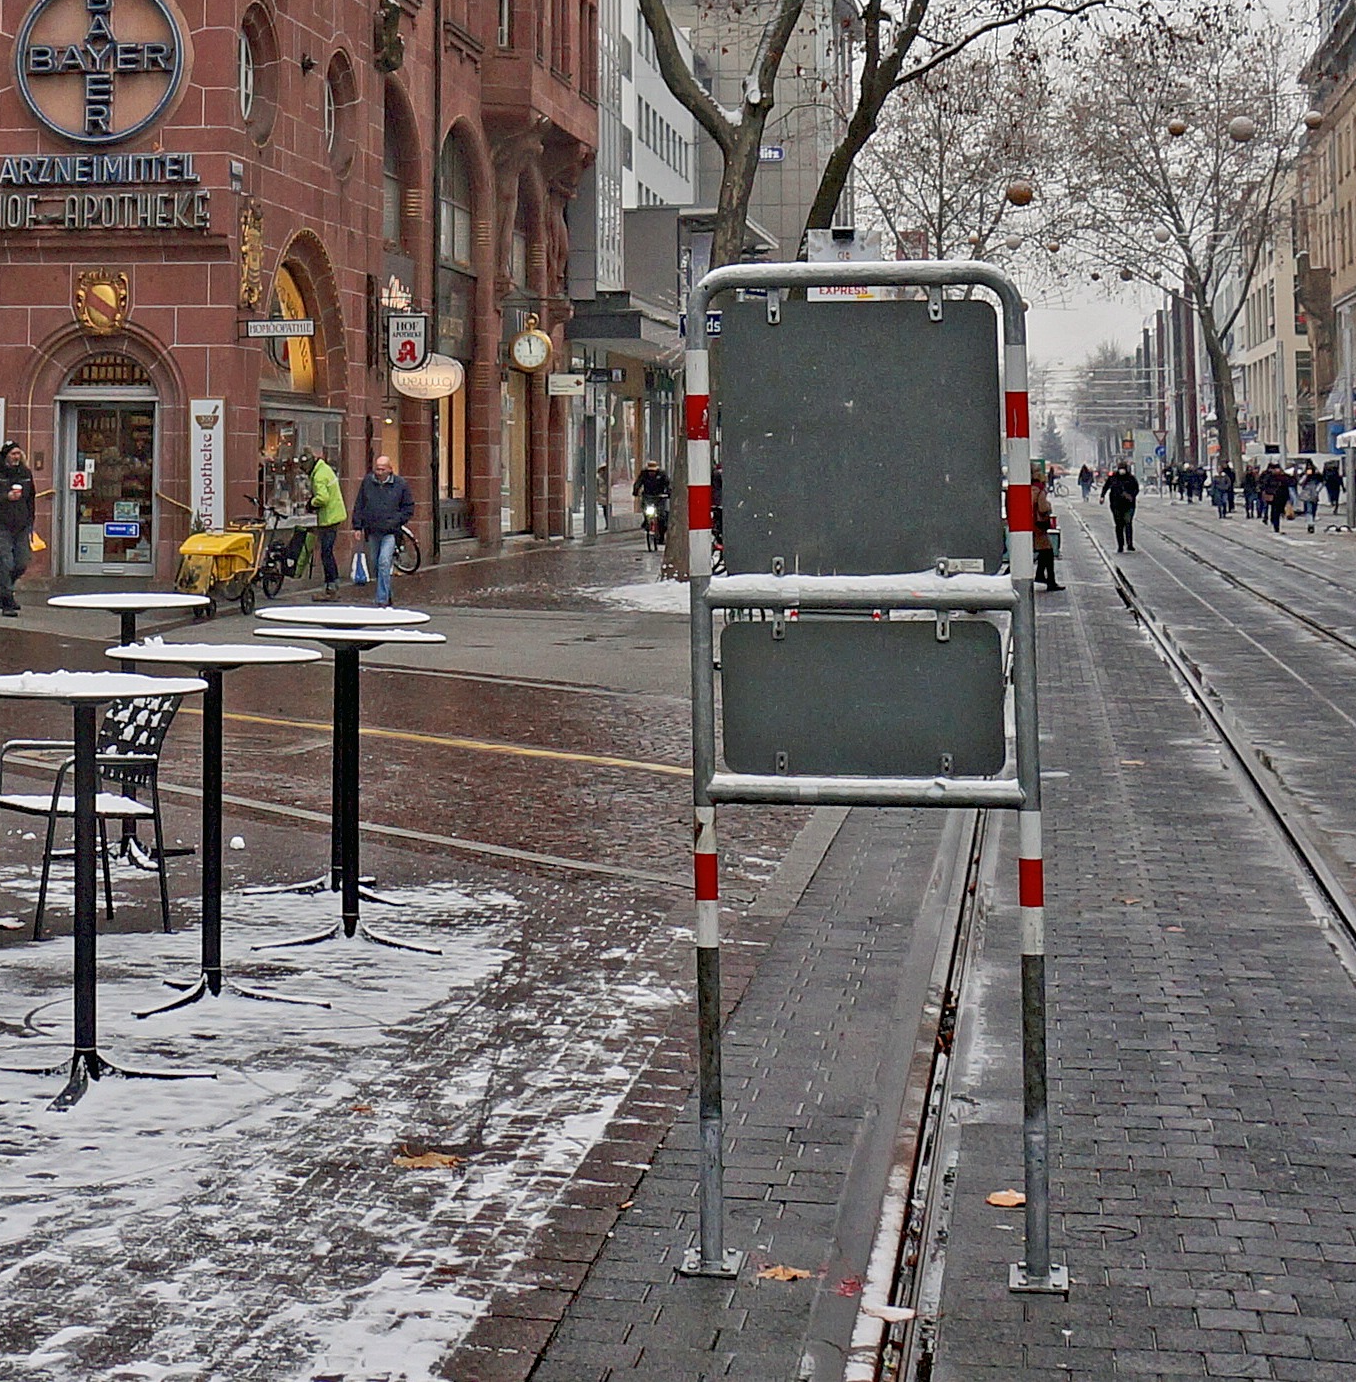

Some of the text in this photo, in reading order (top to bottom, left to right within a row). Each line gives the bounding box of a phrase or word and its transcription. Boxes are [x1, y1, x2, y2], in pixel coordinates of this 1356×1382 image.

[28, 42, 173, 72] BAYER
[63, 189, 211, 230] APOTHEKE
[819, 285, 869, 296] EXPRESS
[199, 433, 217, 533] of-Apotheke
